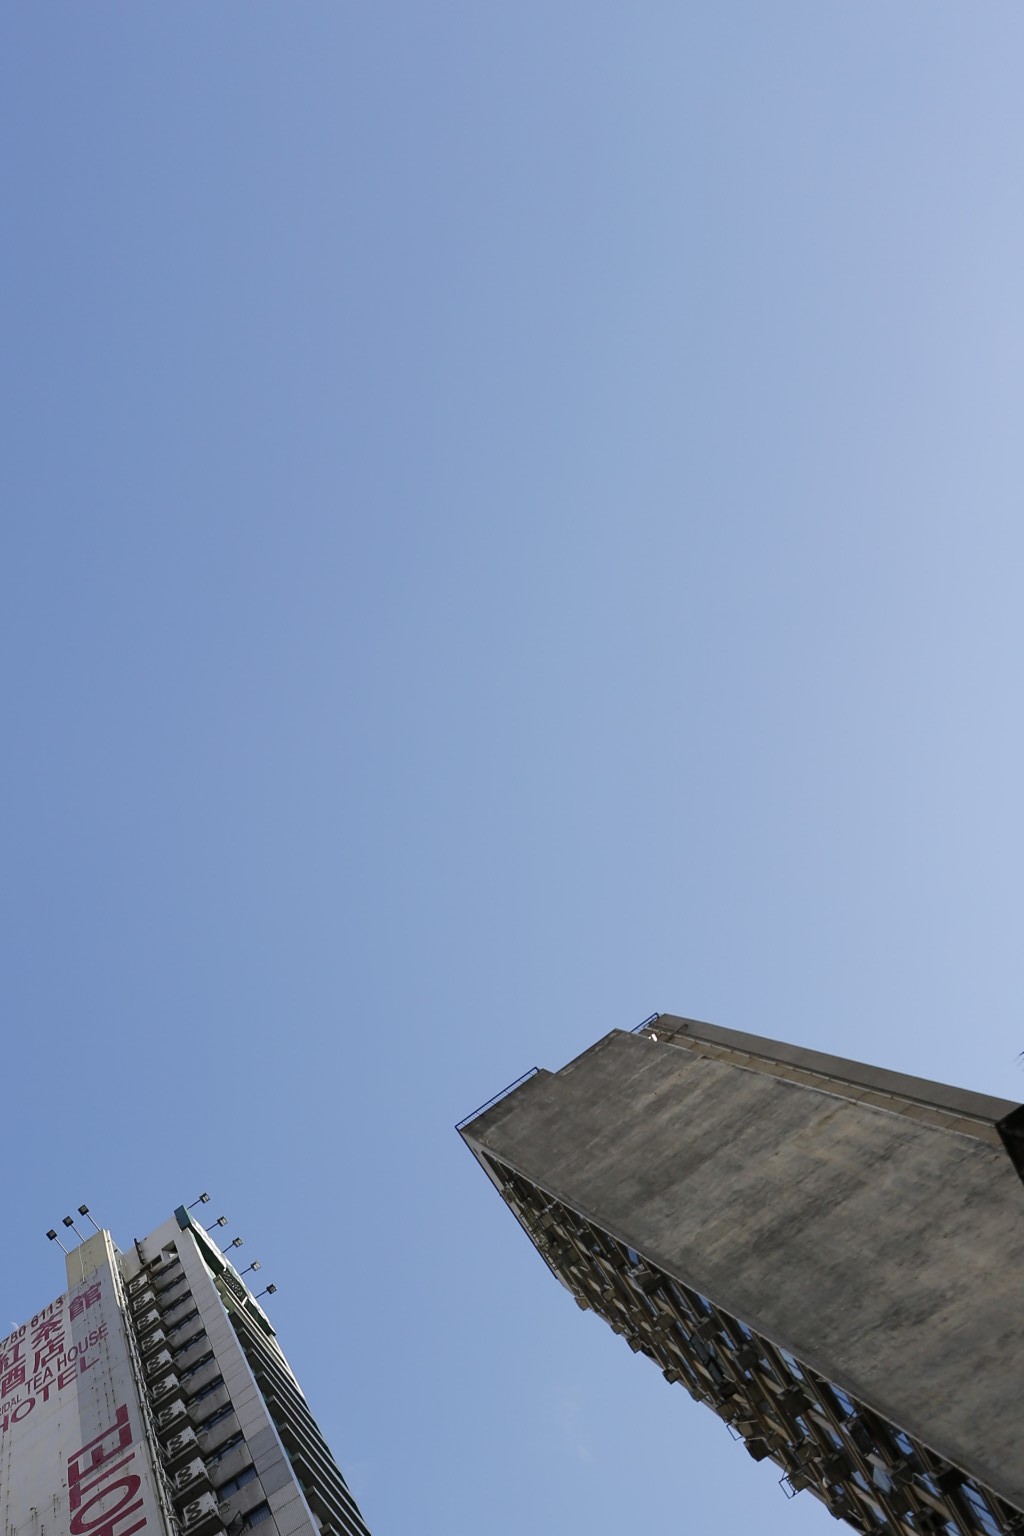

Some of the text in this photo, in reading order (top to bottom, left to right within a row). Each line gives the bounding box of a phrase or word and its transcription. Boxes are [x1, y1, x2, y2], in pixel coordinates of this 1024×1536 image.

[31, 1295, 64, 1328] 6113
[24, 1366, 53, 1395] TEA
[57, 1322, 109, 1371] HOUSE
